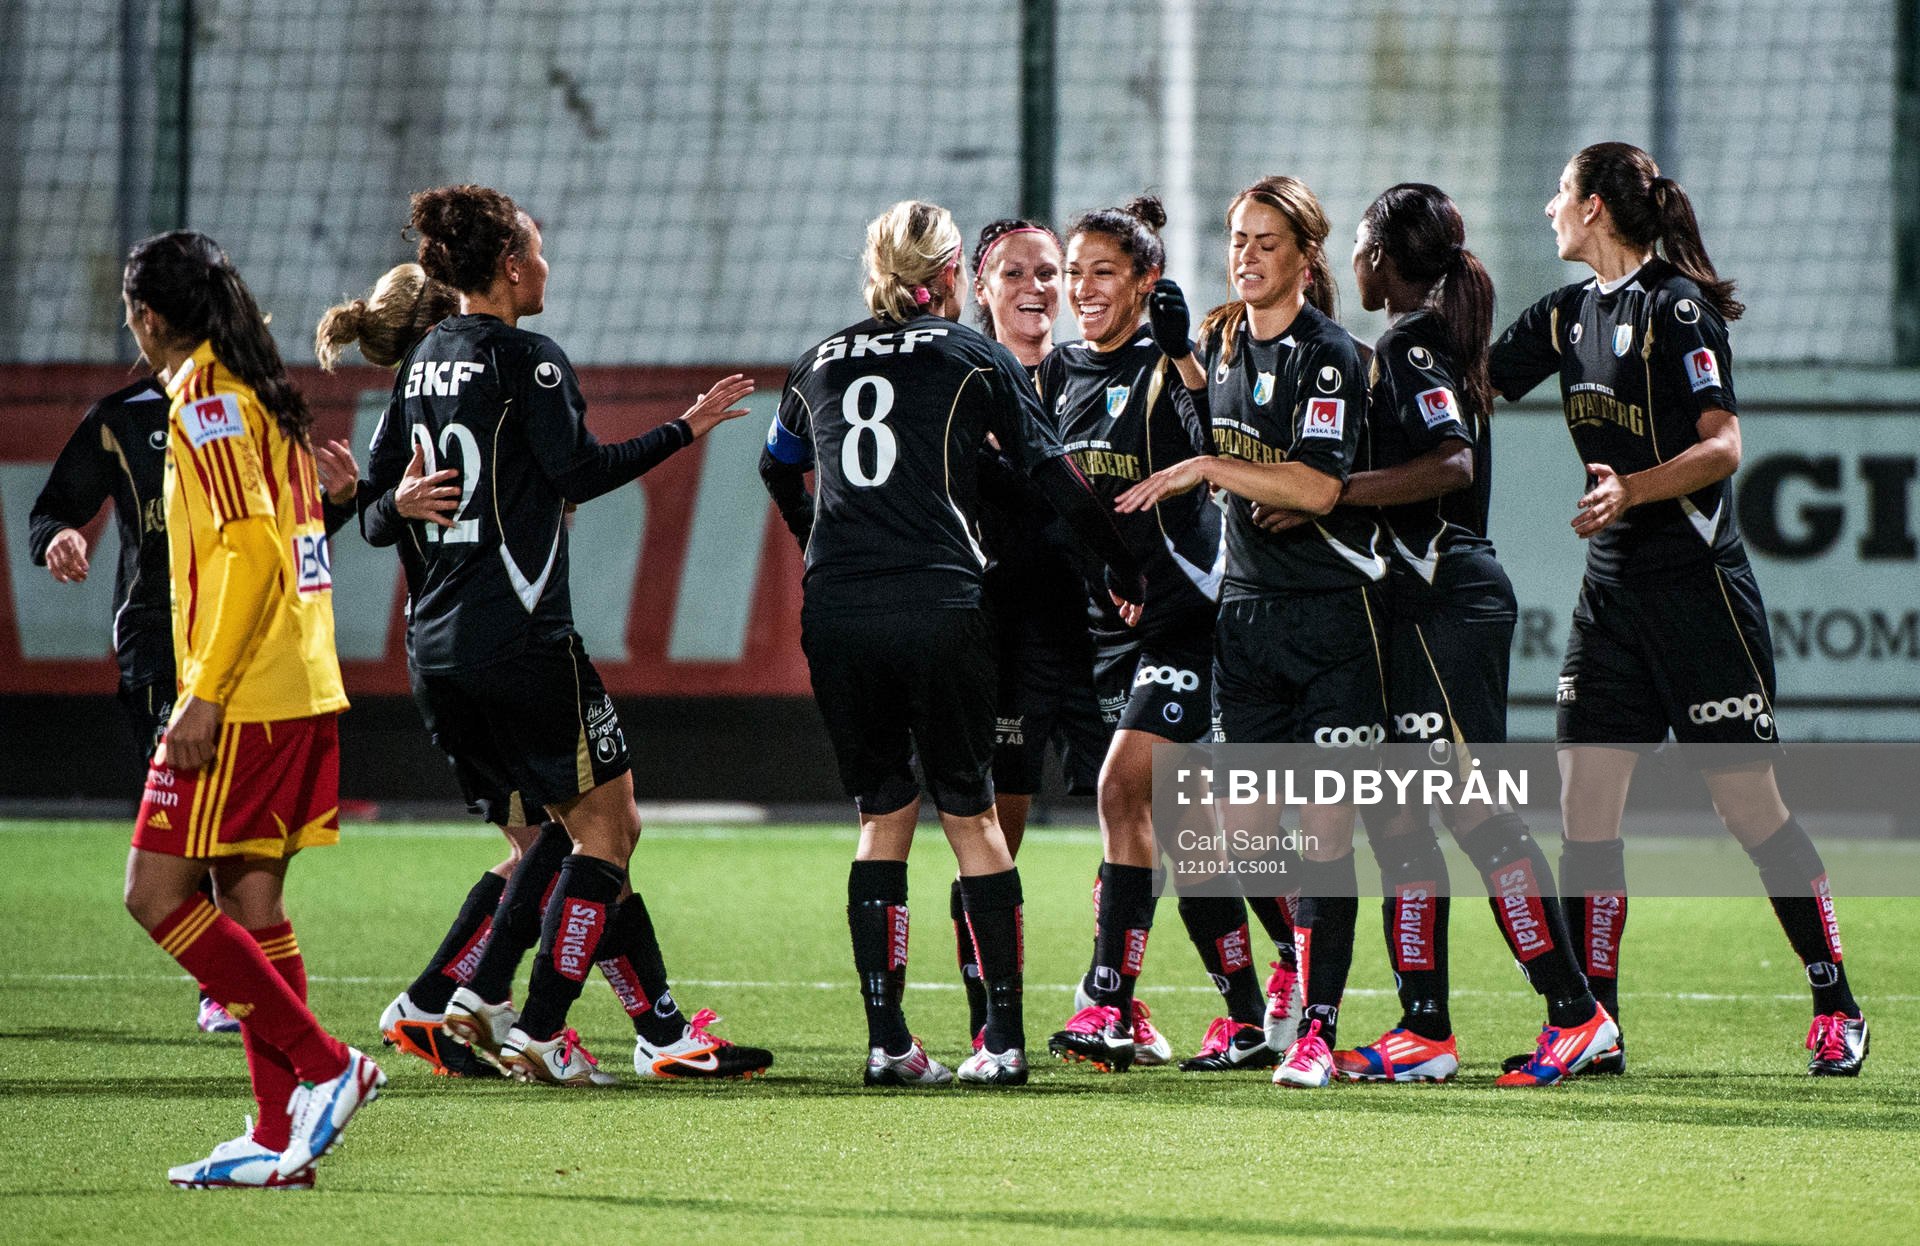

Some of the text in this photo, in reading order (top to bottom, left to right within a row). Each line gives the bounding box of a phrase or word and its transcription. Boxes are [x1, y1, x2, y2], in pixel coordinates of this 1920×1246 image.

[404, 361, 485, 399] SKF
[813, 328, 949, 372] SKF
[841, 375, 897, 487] 8
[1314, 722, 1386, 751] coop
[1688, 693, 1765, 725] coop
[560, 903, 597, 977] Stavdal
[1400, 887, 1428, 966] Stavdal
[1499, 869, 1546, 953] Stavdal
[1591, 894, 1620, 973] Stavdal
